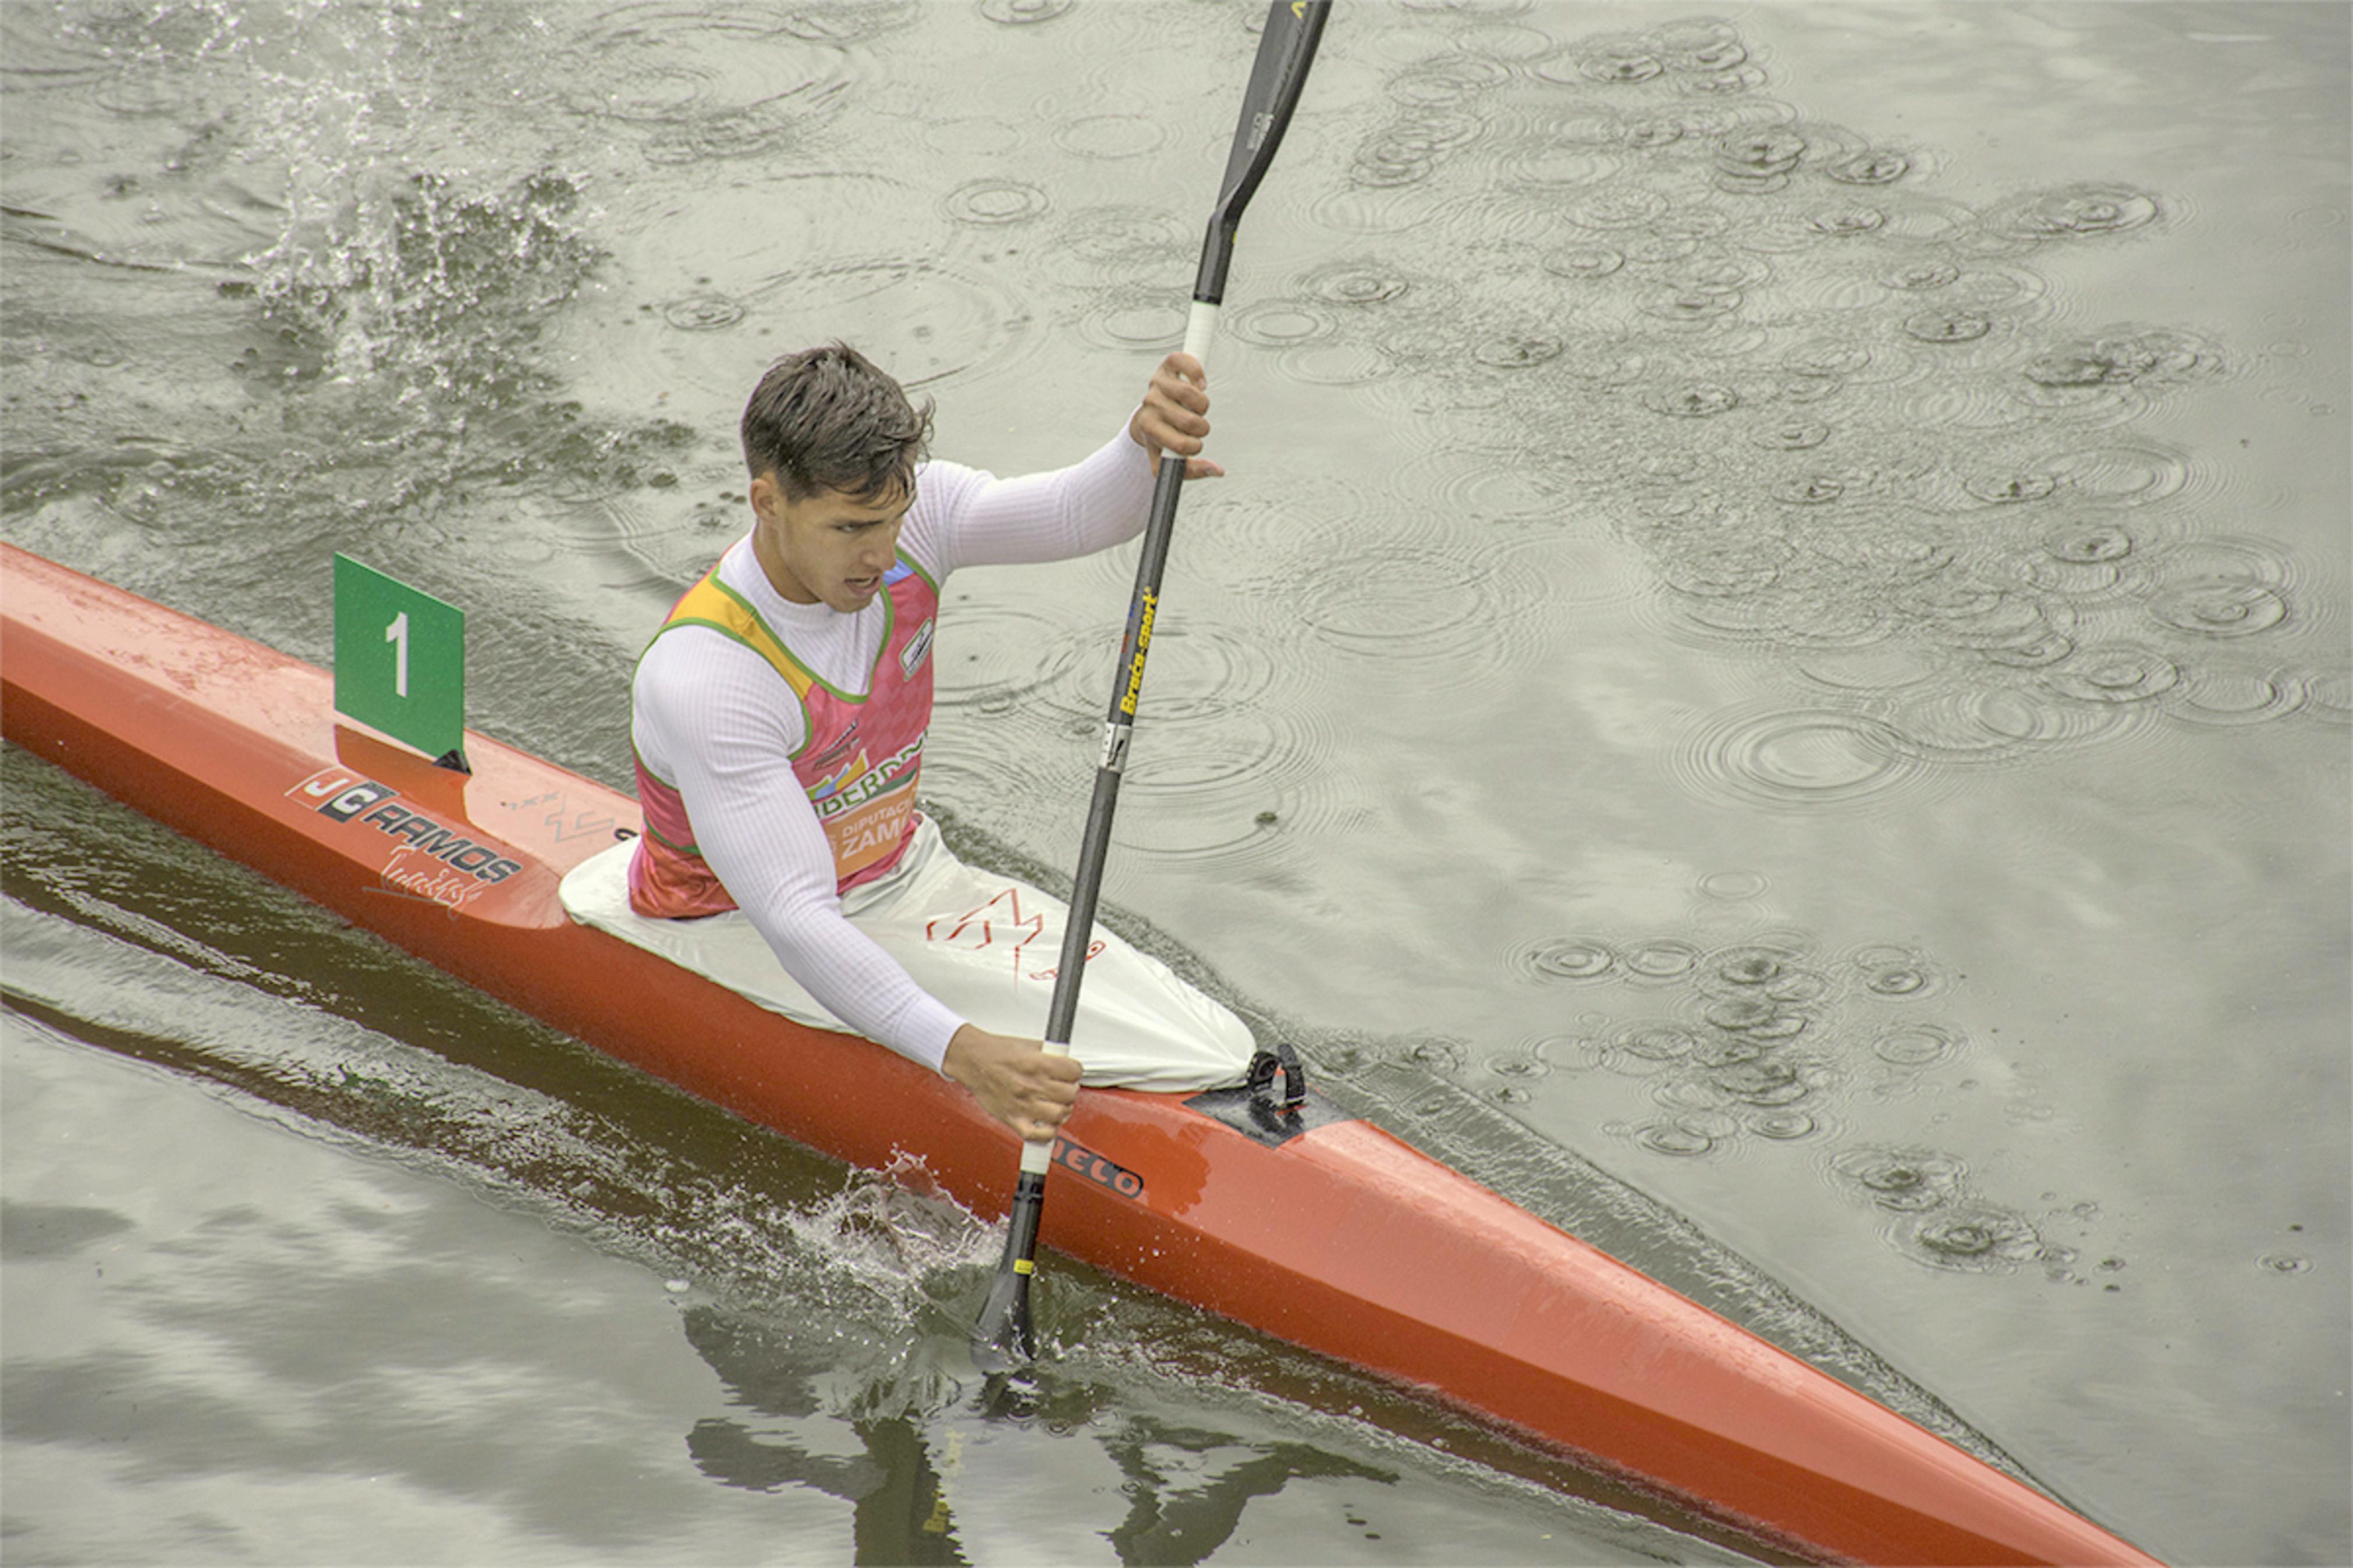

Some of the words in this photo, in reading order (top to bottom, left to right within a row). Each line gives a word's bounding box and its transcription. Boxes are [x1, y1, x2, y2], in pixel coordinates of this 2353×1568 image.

[385, 611, 408, 698] 1
[360, 802, 524, 884] RAMOS
[841, 814, 906, 860] ZAM
